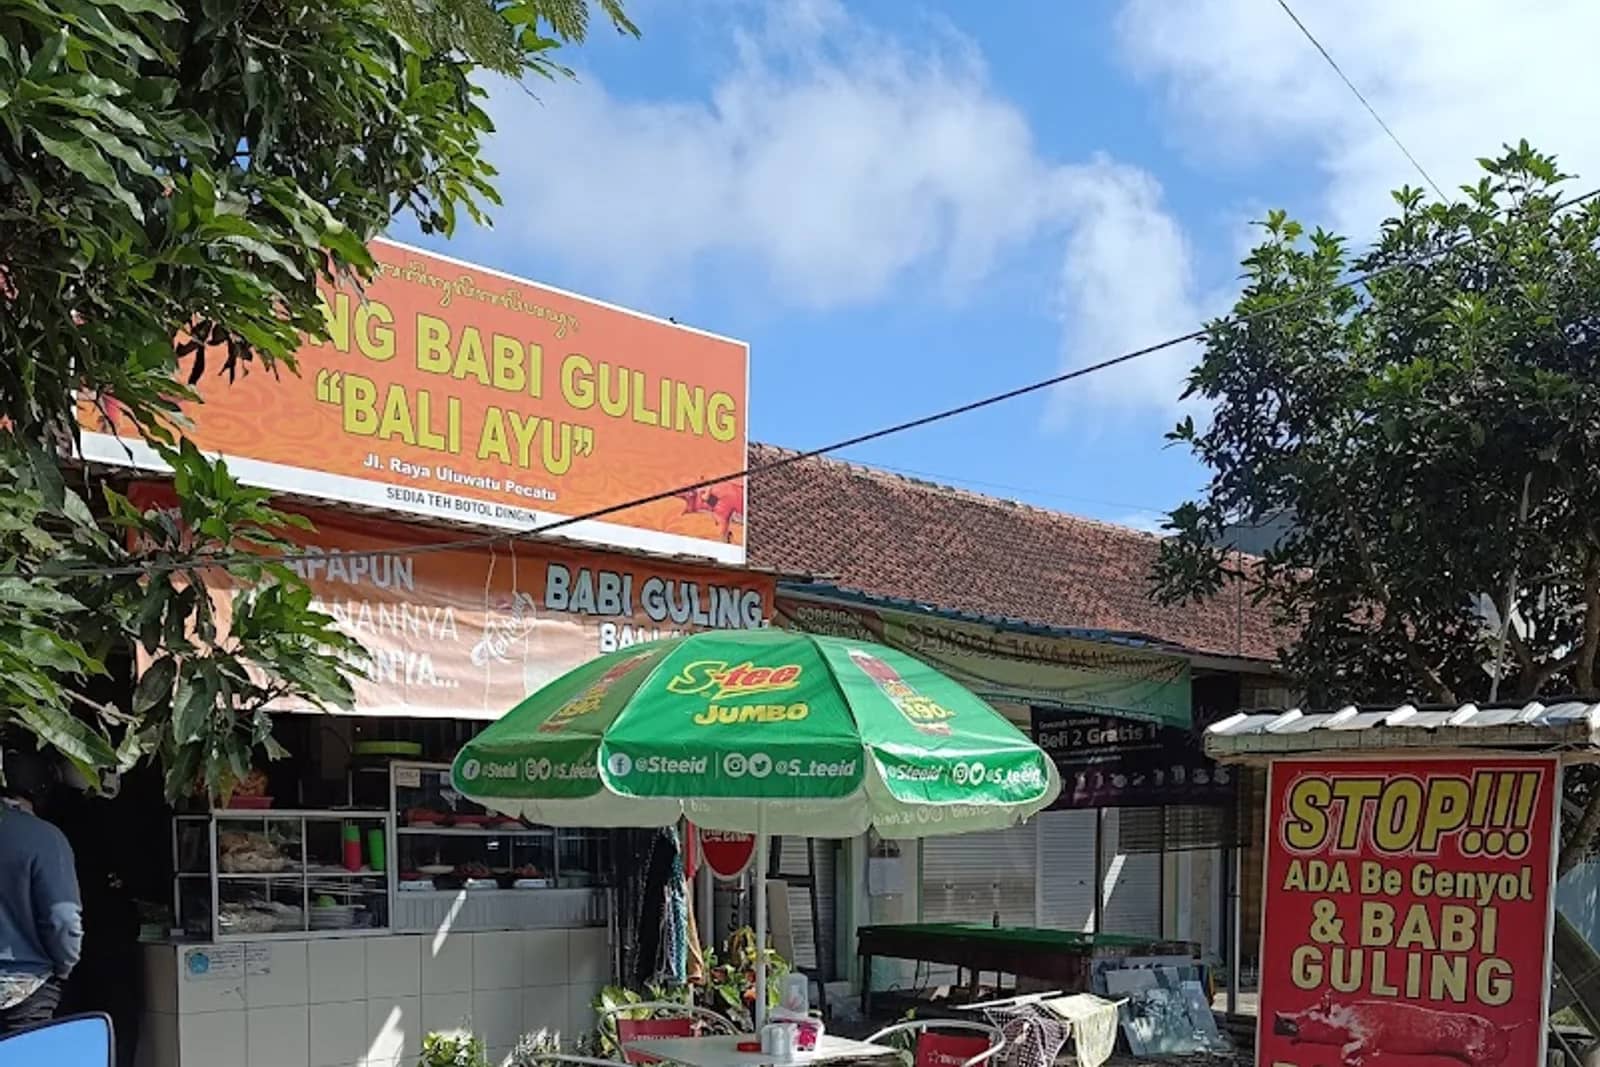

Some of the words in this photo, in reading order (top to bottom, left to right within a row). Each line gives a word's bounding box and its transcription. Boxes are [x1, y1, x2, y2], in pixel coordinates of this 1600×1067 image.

[311, 290, 397, 361] NG
[416, 313, 543, 398] BABI
[561, 354, 738, 442] GULING
[363, 453, 385, 469] Jl.
[390, 457, 431, 478] Raya
[436, 466, 501, 491] Uluwatu
[505, 480, 557, 501] Pecatu
[386, 487, 425, 505] SEDIA
[428, 494, 452, 510] TEH
[455, 499, 493, 517] BOTOL
[495, 505, 537, 523] DINGIN
[545, 563, 634, 618] BABI
[640, 576, 764, 629] GULING
[694, 703, 809, 725] JUMBO
[1039, 730, 1068, 748] Beli
[1072, 730, 1082, 746] 2
[1087, 724, 1144, 744] Gratis
[635, 757, 708, 773] @Steeid
[776, 759, 856, 777] @S_teeid
[1281, 769, 1543, 857] STOP!!!
[1283, 860, 1351, 893] ADA
[1360, 861, 1402, 896] Be
[1411, 864, 1533, 906] Genyol
[1310, 899, 1345, 945] &
[1361, 901, 1498, 954] BABI
[1291, 945, 1514, 1006] GULING
